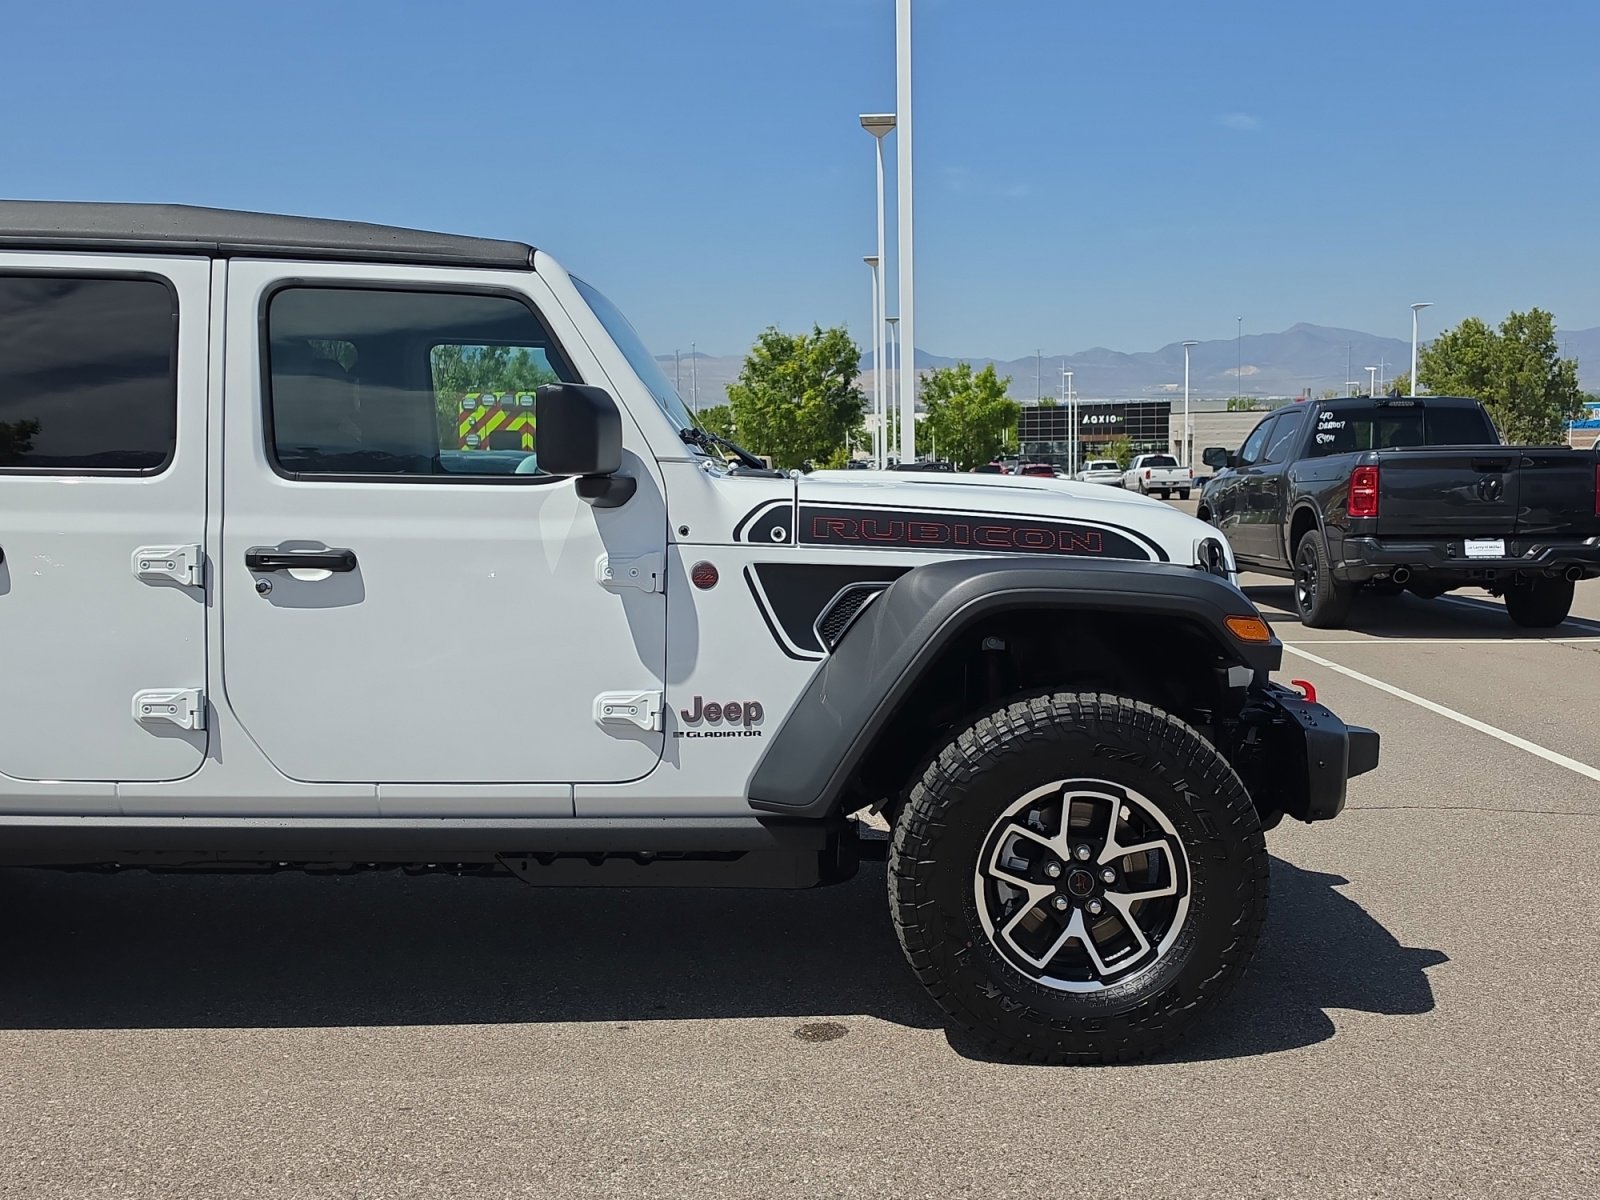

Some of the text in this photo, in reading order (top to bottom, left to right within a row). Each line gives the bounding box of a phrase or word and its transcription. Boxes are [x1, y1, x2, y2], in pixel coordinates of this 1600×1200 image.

[812, 516, 1103, 552] RUBICON
[680, 695, 764, 727] Jeep
[686, 730, 762, 738] GLADIATOR
